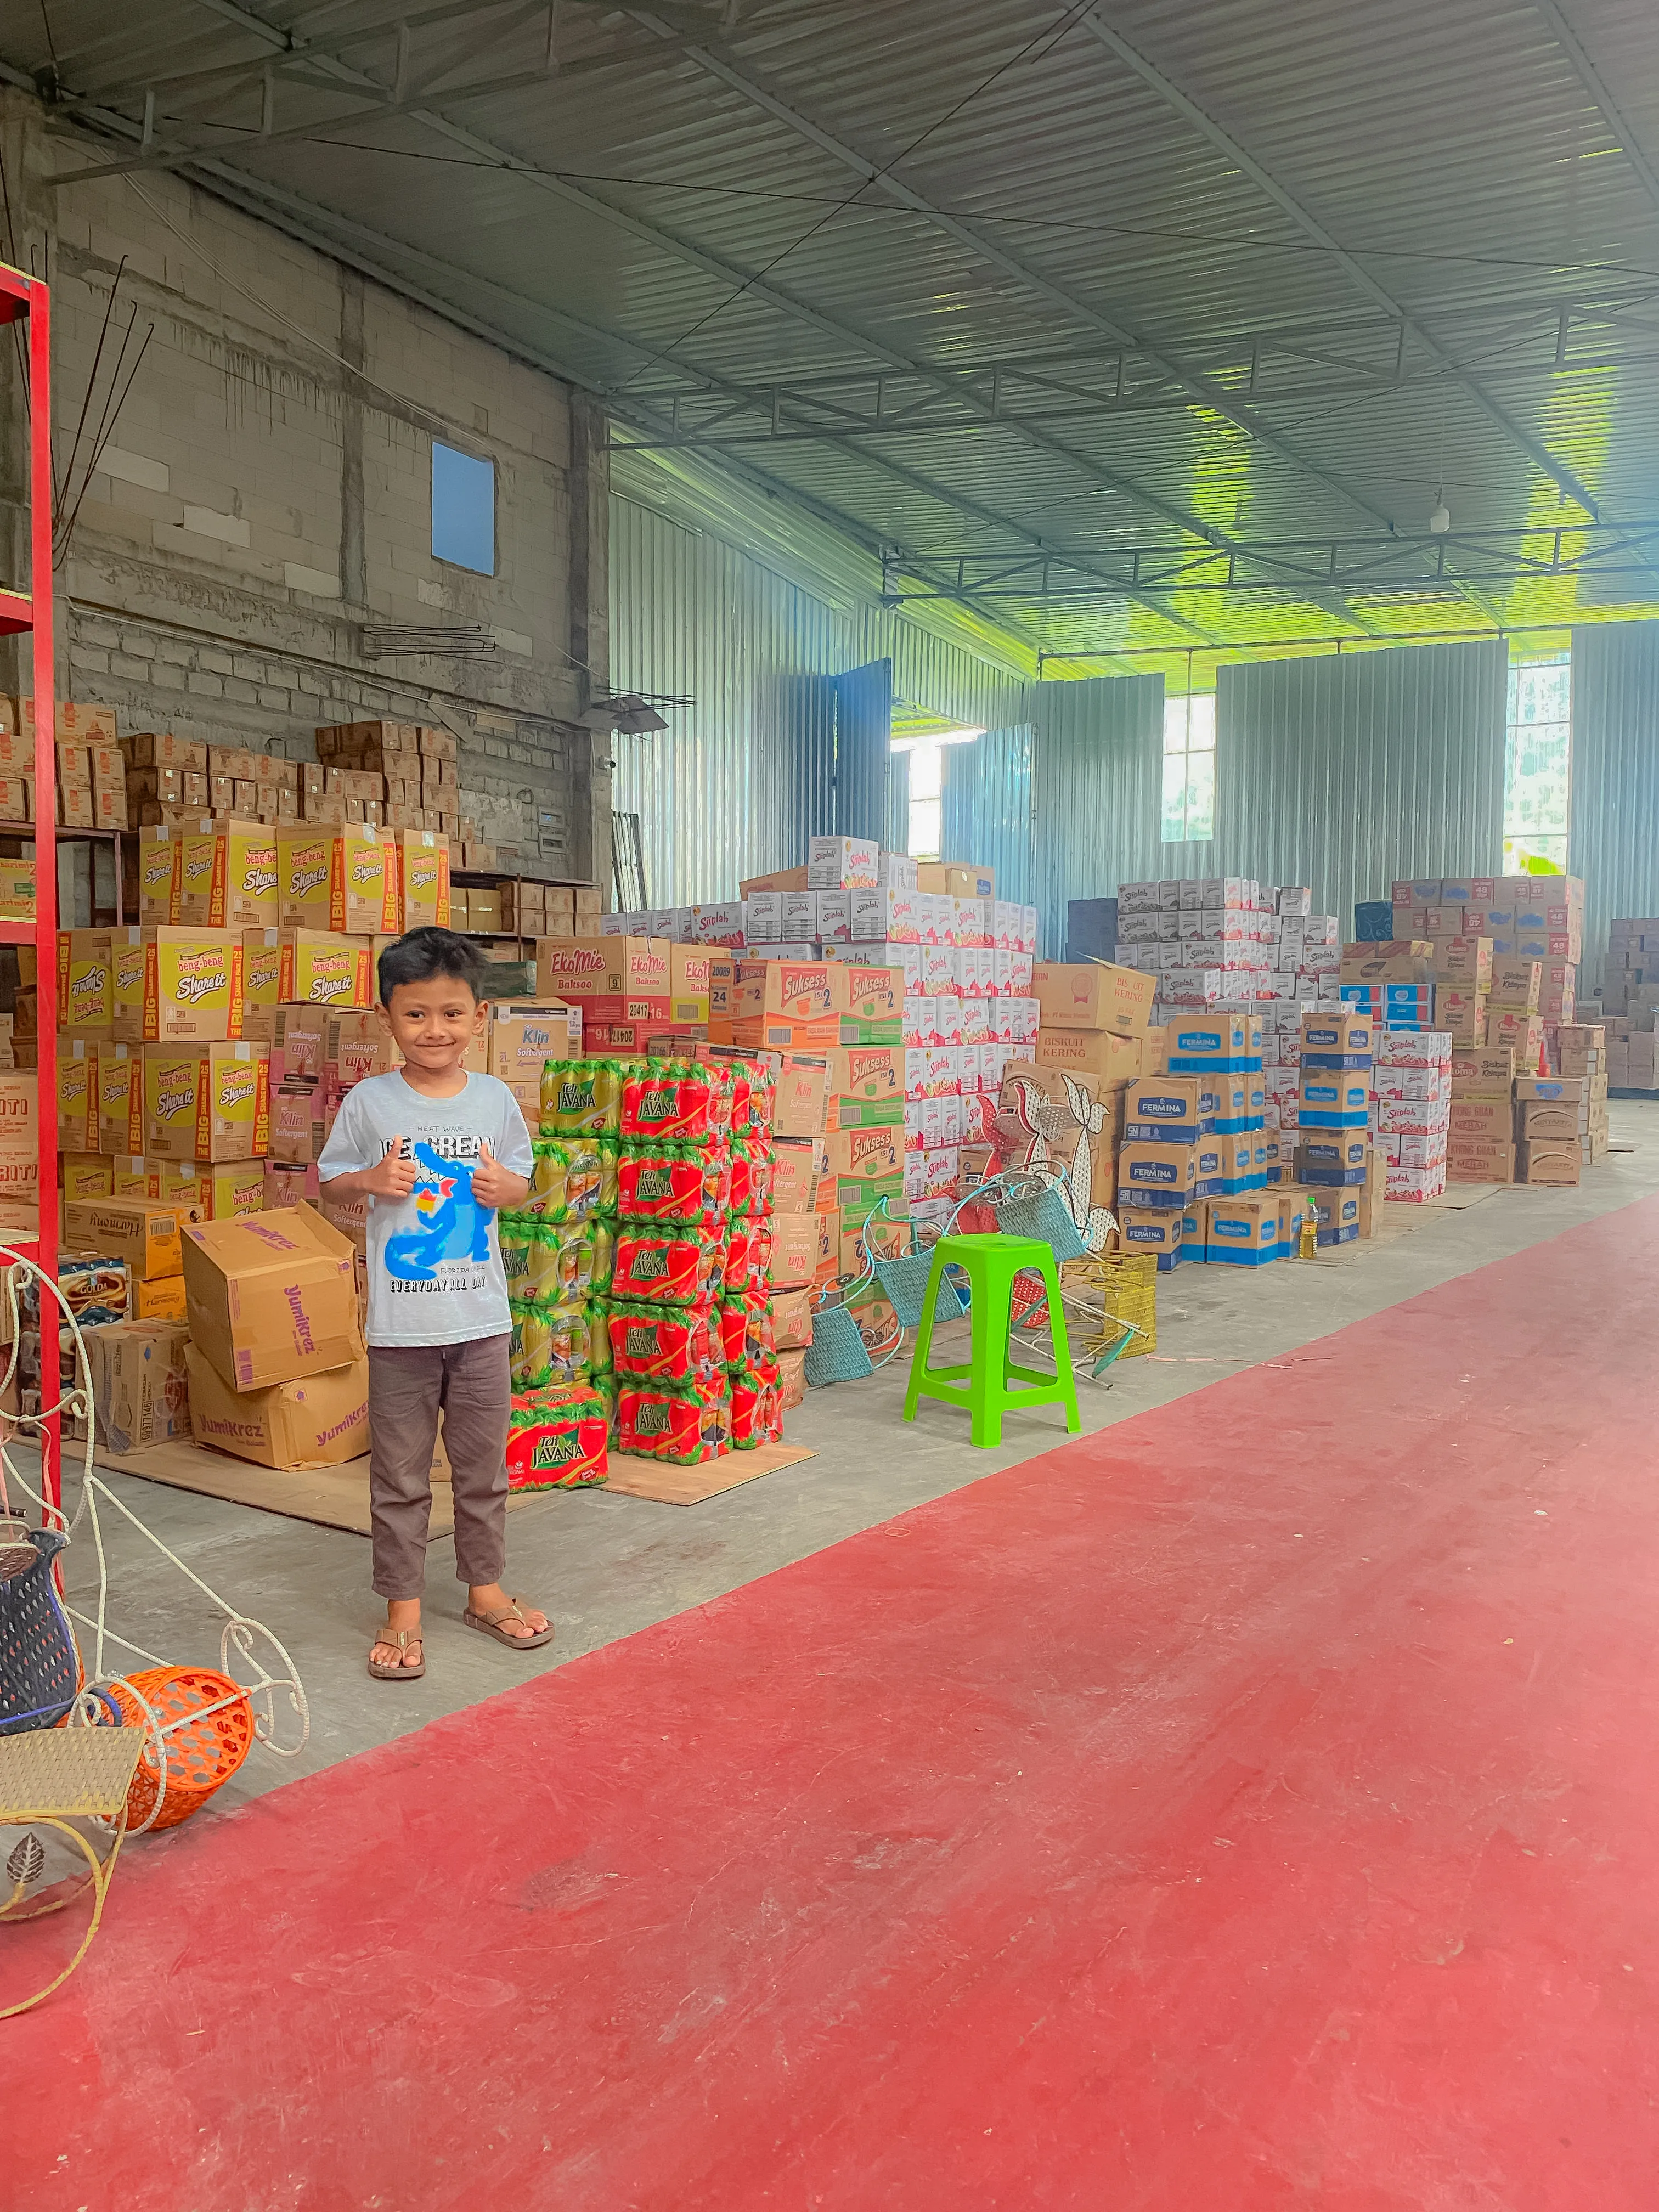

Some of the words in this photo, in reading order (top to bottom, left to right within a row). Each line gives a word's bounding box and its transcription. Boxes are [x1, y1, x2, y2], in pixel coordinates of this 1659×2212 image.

[334, 843, 342, 851] 25
[385, 847, 394, 855] 25
[291, 850, 325, 868] beng-beng
[439, 854, 447, 862] 25
[243, 868, 278, 895] Share
[699, 911, 729, 931] Siiplah
[147, 948, 156, 957] 25
[233, 950, 242, 960] 25
[178, 956, 224, 972] beng-beng
[312, 960, 350, 973] beng-beng
[713, 966, 730, 977] 20089
[176, 974, 213, 1003] Share
[213, 972, 226, 986] it
[309, 977, 342, 1002] Share
[342, 975, 352, 989] it
[612, 979, 618, 988] 9
[713, 991, 726, 1002] 24
[755, 989, 760, 999] 2
[823, 989, 831, 1007] 2
[888, 990, 894, 1008] 2
[1115, 988, 1143, 1002] KERING
[232, 998, 242, 1026] BIG
[629, 1005, 647, 1017] 20417
[523, 1030, 549, 1043] Klin
[613, 1030, 633, 1042] 20417
[1045, 1037, 1084, 1047] BISKUIT
[341, 1042, 378, 1053] Softergent
[1387, 1039, 1417, 1052] Siiplah
[517, 1047, 554, 1058] Softergent
[1043, 1048, 1086, 1058] KERING
[200, 1065, 209, 1074] 25
[259, 1065, 268, 1074] 25
[345, 1056, 373, 1072] Klin
[157, 1071, 191, 1087] beng-beng
[221, 1071, 253, 1085] beng-beng
[888, 1068, 895, 1086] 2
[219, 1086, 245, 1107] Share
[245, 1082, 255, 1096] it
[562, 1083, 577, 1094] Teh
[796, 1082, 812, 1097] Klin
[557, 1092, 596, 1113] JAVANA
[646, 1091, 660, 1102] Teh
[156, 1090, 183, 1120] Share
[183, 1090, 194, 1104] it
[639, 1101, 680, 1121] JAVANA
[1142, 1104, 1181, 1112] FERMINA
[280, 1111, 305, 1126] Klin
[1387, 1107, 1417, 1120] Siiplah
[131, 1114, 141, 1142] BIG
[198, 1116, 209, 1146] BIG
[256, 1114, 269, 1142] BIG
[275, 1128, 308, 1139] Softergent
[255, 1144, 268, 1153] THE
[888, 1146, 895, 1164] 2
[775, 1160, 795, 1176] Klin
[928, 1156, 949, 1178] Siiplah
[1133, 1169, 1172, 1178] FERMINA
[640, 1169, 656, 1181] Teh
[1386, 1173, 1409, 1184] iiplah
[150, 1180, 157, 1189] 25
[201, 1184, 211, 1193] 25
[636, 1180, 675, 1198] JAVANA
[1129, 1231, 1161, 1239] FERMINA
[823, 1236, 829, 1255] 2
[855, 1240, 862, 1257] 2
[637, 1250, 653, 1261] Teh
[631, 1260, 670, 1278] JAVANA
[788, 1255, 806, 1271] Klin
[80, 1282, 108, 1294] GOLDA
[390, 1279, 447, 1293] EVERYDAY
[450, 1278, 467, 1290] ALL
[472, 1276, 486, 1289] DAY
[628, 1328, 643, 1339] Teh
[626, 1338, 663, 1355] JAVANA
[640, 1403, 654, 1414] Teh
[636, 1411, 673, 1434] JAVANA
[539, 1436, 557, 1447] Teh
[531, 1444, 587, 1470] JAVANA
